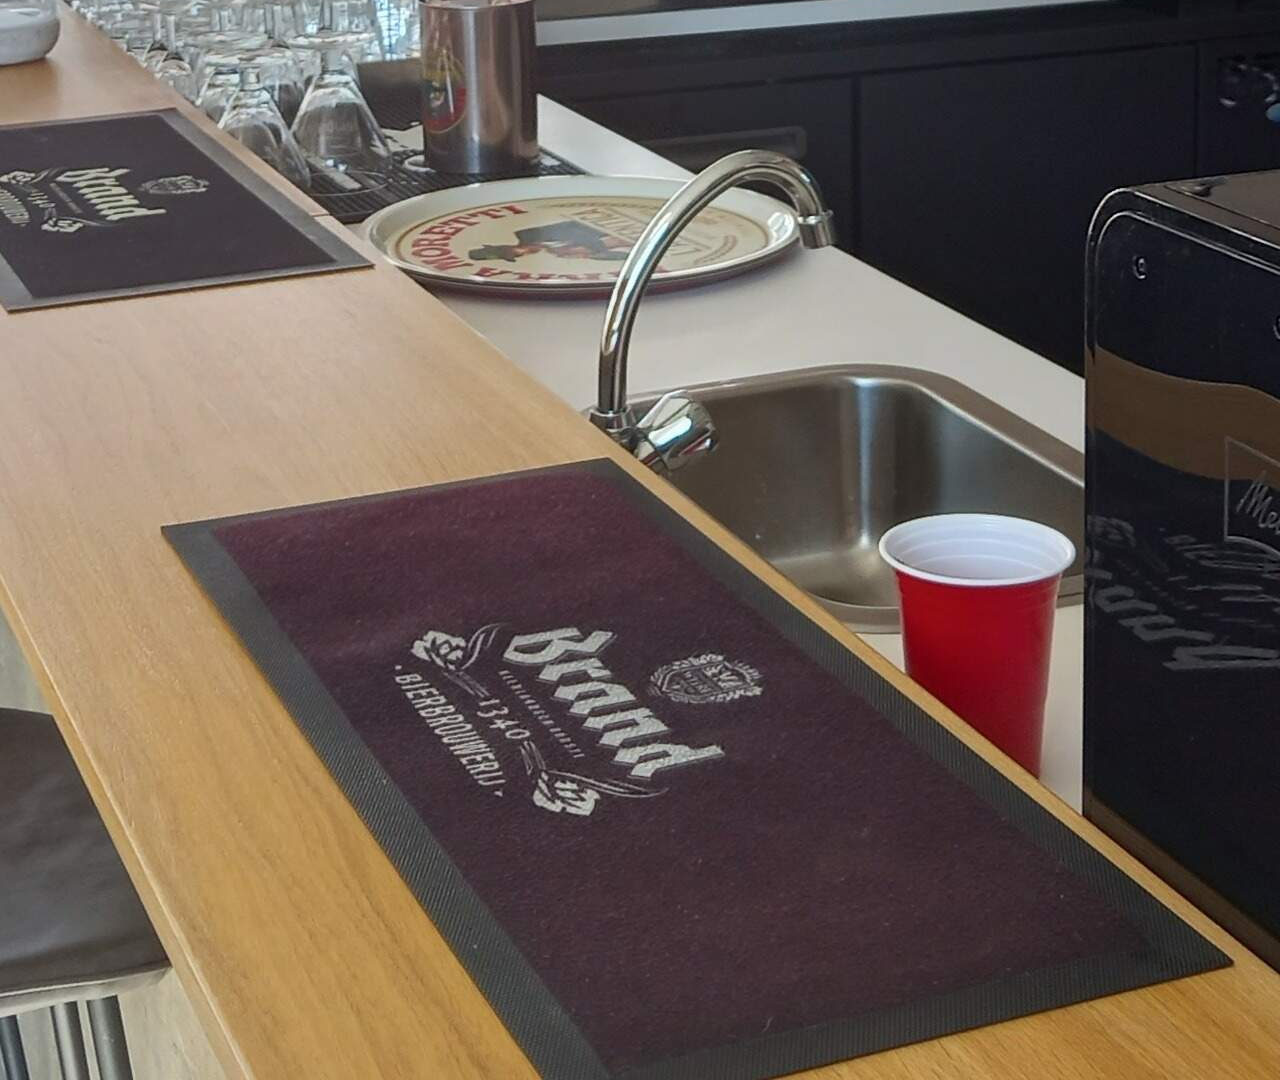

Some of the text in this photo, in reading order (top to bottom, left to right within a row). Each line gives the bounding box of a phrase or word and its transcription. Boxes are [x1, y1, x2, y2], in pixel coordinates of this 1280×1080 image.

[411, 203, 529, 272] MORETTI
[395, 670, 507, 789] BIERBROUWERIJ
[476, 697, 531, 741] 1340
[501, 626, 726, 781] Brand
